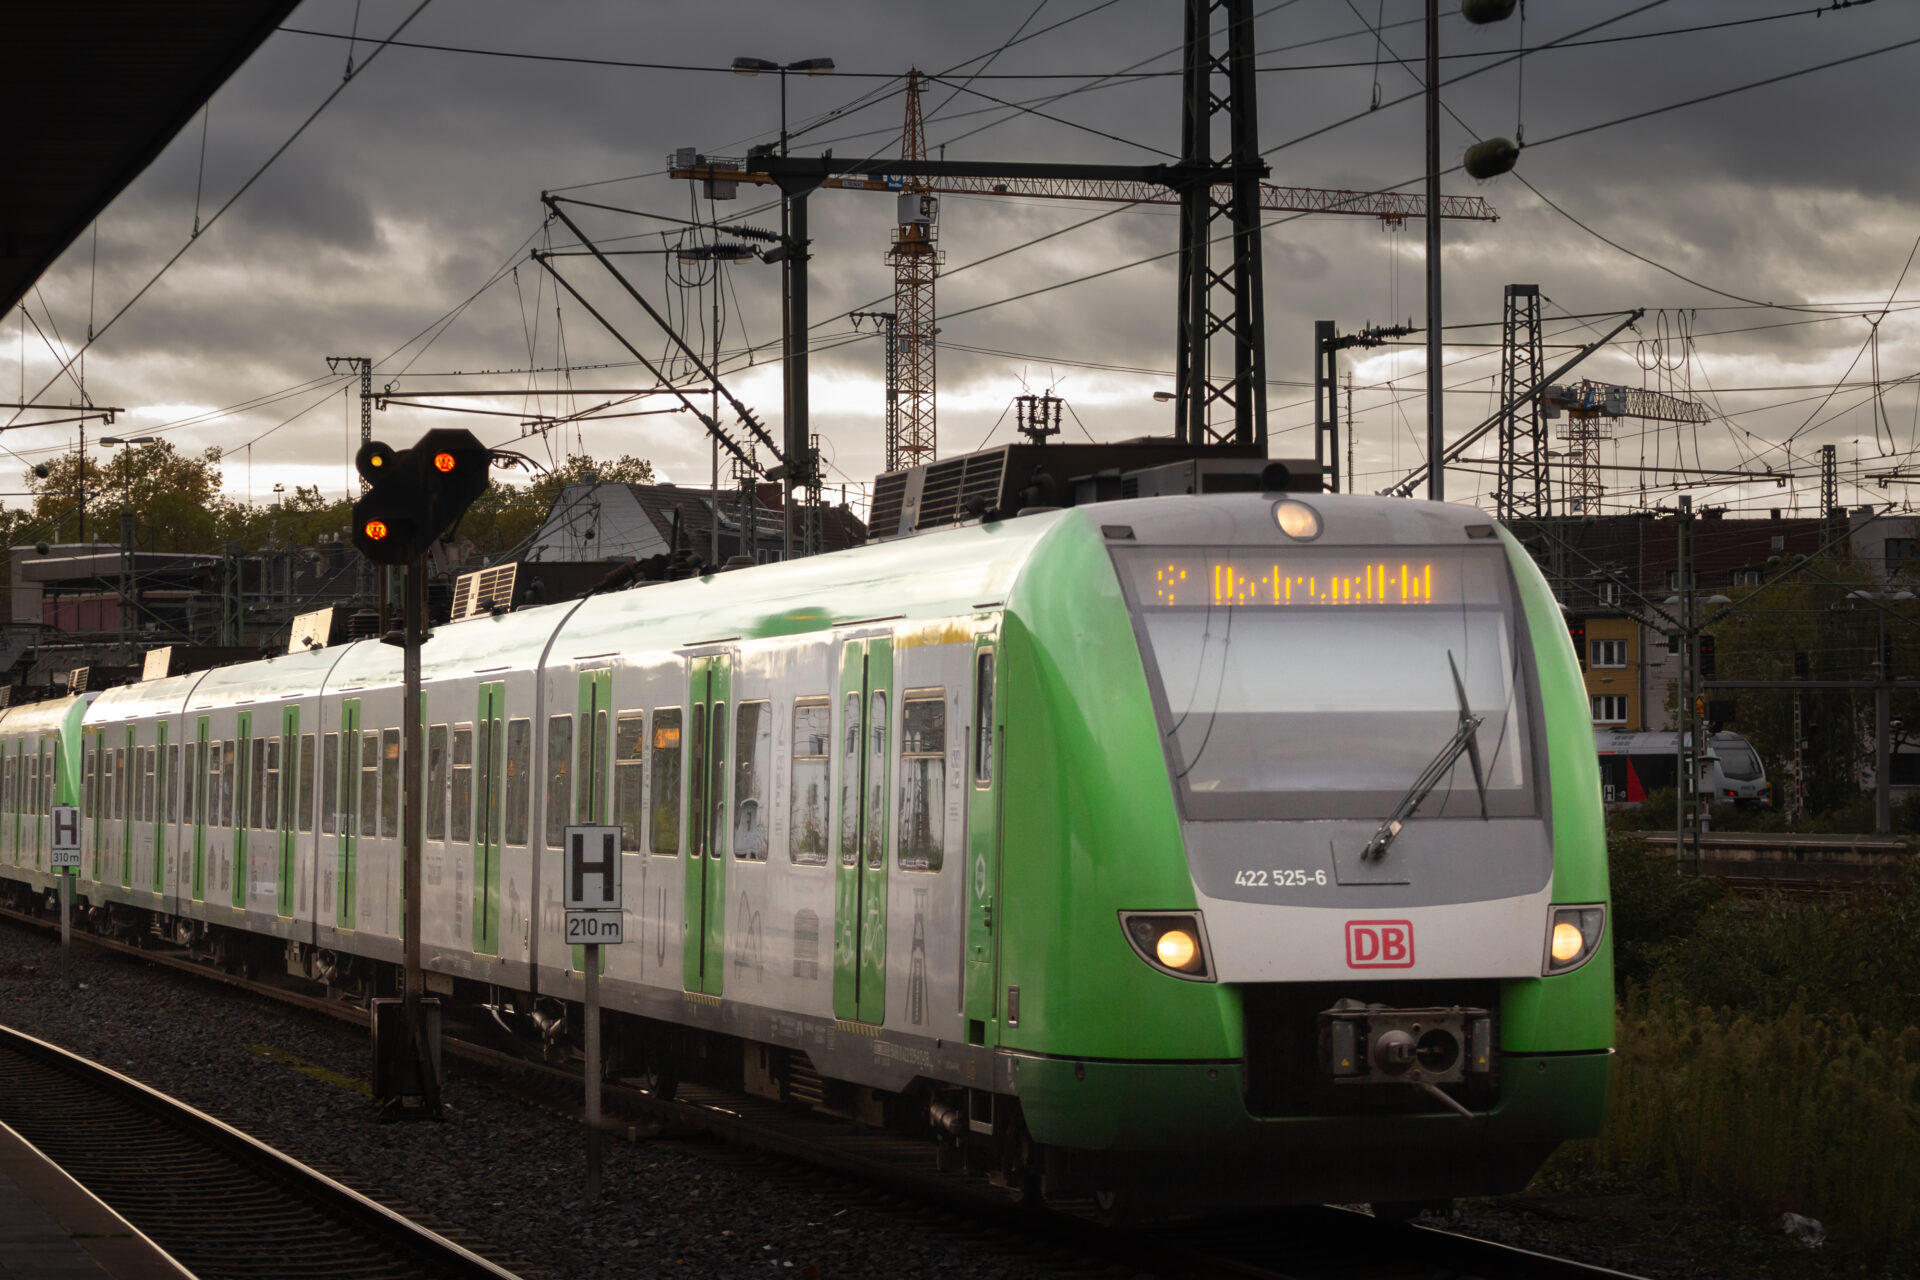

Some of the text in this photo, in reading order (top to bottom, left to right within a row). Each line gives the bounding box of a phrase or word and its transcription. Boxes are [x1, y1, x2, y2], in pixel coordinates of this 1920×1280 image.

[55, 810, 77, 845] H
[54, 852, 69, 862] 310
[572, 833, 615, 901] H
[1234, 869, 1328, 887] 422 525-6
[569, 918, 619, 936] 210 m
[1353, 927, 1408, 961] DB
